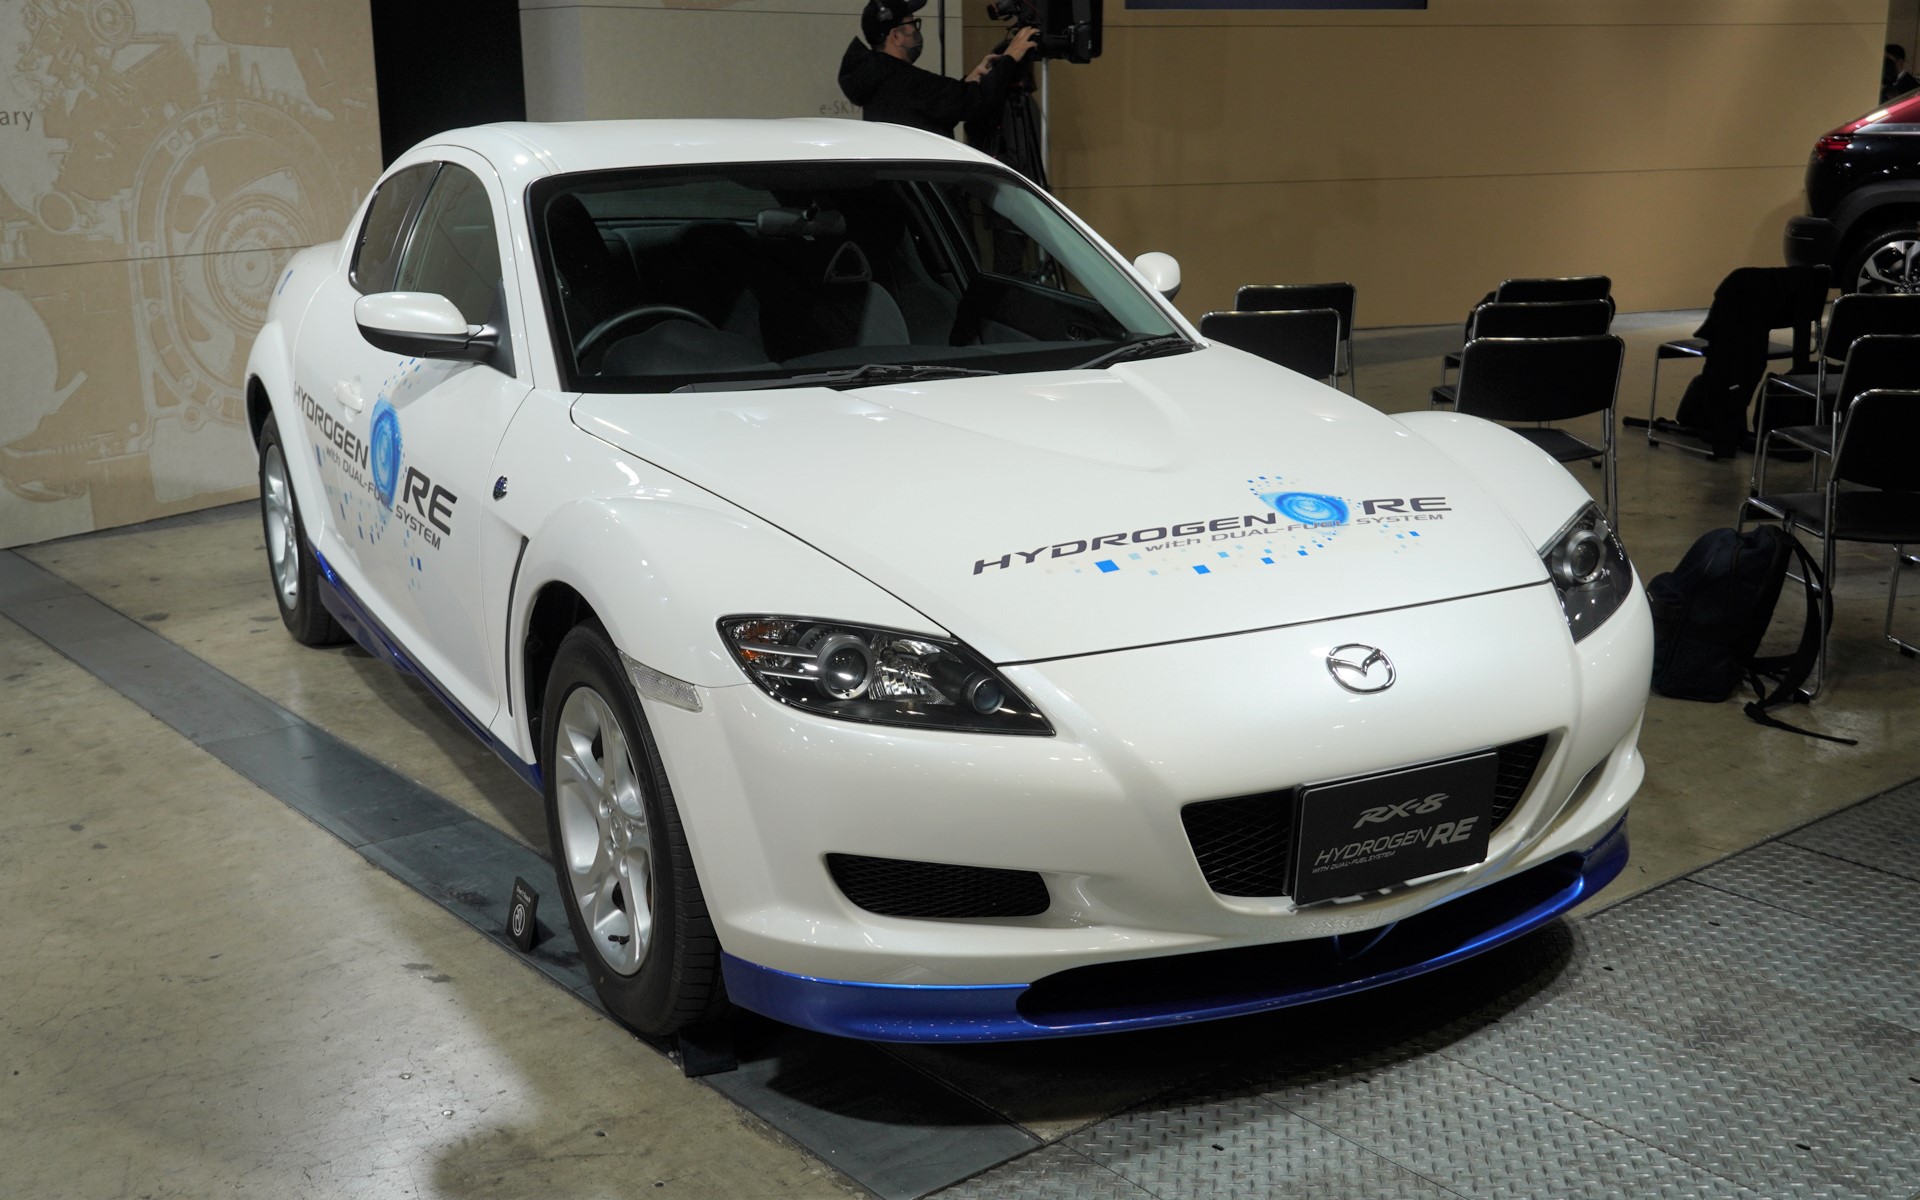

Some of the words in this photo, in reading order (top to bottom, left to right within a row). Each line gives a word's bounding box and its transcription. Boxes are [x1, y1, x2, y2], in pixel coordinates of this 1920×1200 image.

[293, 380, 369, 470] HYDROGEN
[403, 466, 458, 536] RE
[326, 444, 341, 466] with
[343, 459, 393, 512] DUAL-FUEL
[395, 504, 441, 551] SYSTEM
[973, 512, 1277, 575] HYDROGEN
[1362, 496, 1452, 515] RE
[1145, 537, 1201, 552] with
[1211, 520, 1350, 542] DUAL-FUEL
[1356, 513, 1444, 525] SYSTEM
[1352, 793, 1450, 829] RX-8
[1312, 864, 1330, 874] WITH
